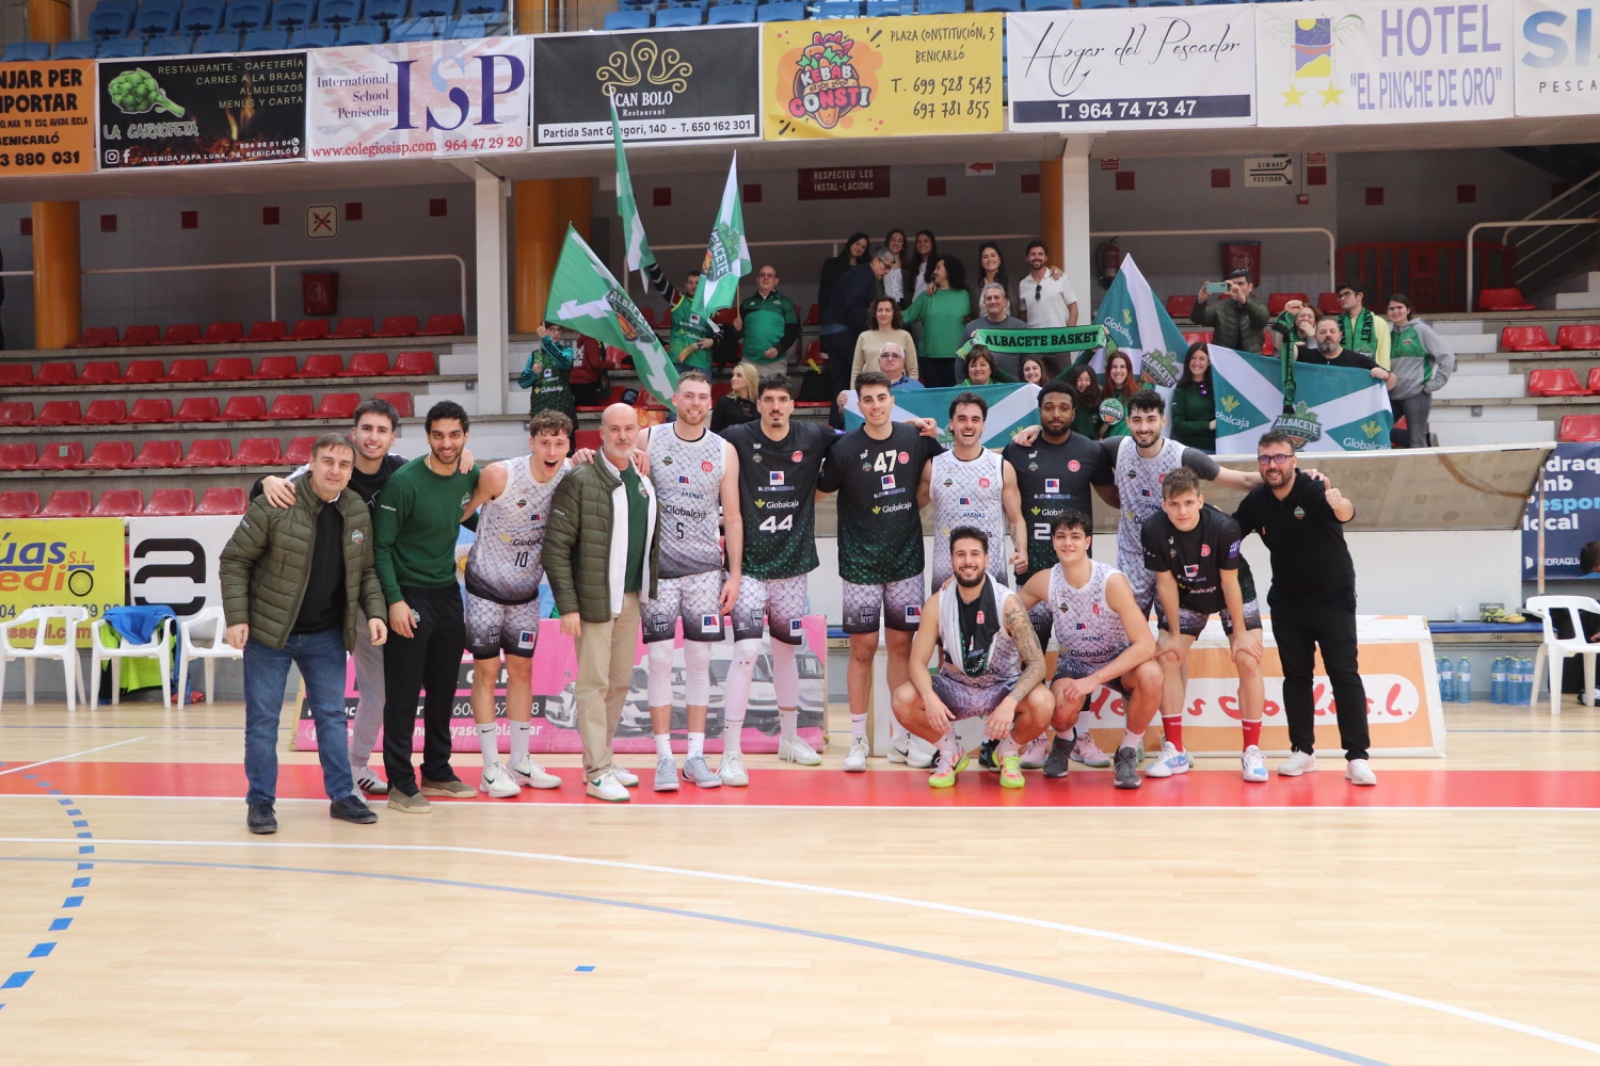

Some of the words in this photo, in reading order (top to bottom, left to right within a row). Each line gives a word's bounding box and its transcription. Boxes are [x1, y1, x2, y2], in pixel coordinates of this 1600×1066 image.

[890, 29, 918, 42] PLAZA
[989, 27, 995, 41] 3
[1381, 4, 1501, 57] HOTEL
[1521, 8, 1600, 69] SI
[915, 45, 965, 63] BENICARLÓ
[1021, 19, 1105, 98] Hogar
[1114, 23, 1147, 65] del
[1148, 16, 1241, 65] Pescador
[158, 63, 234, 75] RESTAURANTE
[244, 58, 304, 71] CAFETERÍA
[800, 65, 852, 86] KEBAB
[48, 68, 83, 88] PER
[196, 75, 238, 86] CARNES
[252, 74, 266, 82] LA
[270, 72, 304, 82] BRASA
[317, 73, 389, 88] International
[891, 78, 907, 94] T.
[913, 78, 936, 95] 699
[940, 76, 963, 95] 528
[968, 76, 992, 94] 543
[239, 84, 304, 95] ALMUERZOS
[352, 89, 389, 102] School
[389, 54, 525, 132] ISP
[1379, 69, 1434, 109] PINCHE
[1438, 68, 1458, 107] DE
[0, 93, 78, 113] PORTAR
[269, 96, 304, 106] CARTA
[615, 92, 638, 107] CAN
[642, 91, 673, 106] BOLO
[789, 87, 870, 117] CONSTI
[622, 109, 666, 117] Restaurant
[913, 101, 936, 119] 697
[941, 101, 961, 118] 781
[966, 100, 990, 119] 855
[1057, 103, 1073, 119] T.
[1079, 102, 1112, 119] 964
[1118, 102, 1140, 118] 74
[1147, 101, 1169, 117] 73
[1174, 100, 1197, 116] 47
[0, 131, 60, 146] ENICARLÓ
[543, 128, 579, 139] Partida
[581, 126, 603, 136] Sant
[606, 124, 647, 138] Gegori,
[649, 124, 667, 134] 140
[681, 122, 689, 133] T.
[691, 122, 711, 133] 650
[713, 121, 731, 132] 162
[732, 120, 751, 131] 301
[312, 141, 437, 157] www.colegiosisp.com
[444, 139, 468, 151] 964
[471, 138, 486, 149] 47
[489, 137, 504, 149] 29
[507, 136, 524, 148] 20
[15, 152, 45, 166] 880
[52, 151, 80, 165] 031
[143, 154, 178, 162] AVENIDA
[181, 153, 202, 161] PAPA
[814, 170, 856, 180] RESPECTEU
[860, 169, 874, 179] LES
[985, 334, 1047, 348] ALBACETE
[1050, 331, 1099, 346] BASKET
[1142, 353, 1176, 387] ALBACETE
[1216, 411, 1250, 429] obalcaja
[1275, 417, 1320, 435] ALBACETE
[873, 449, 897, 473] 47
[1546, 456, 1600, 474] draq
[676, 522, 684, 539] 5
[758, 514, 793, 533] 44
[68, 551, 95, 564] S.L.
[514, 551, 529, 567] 10
